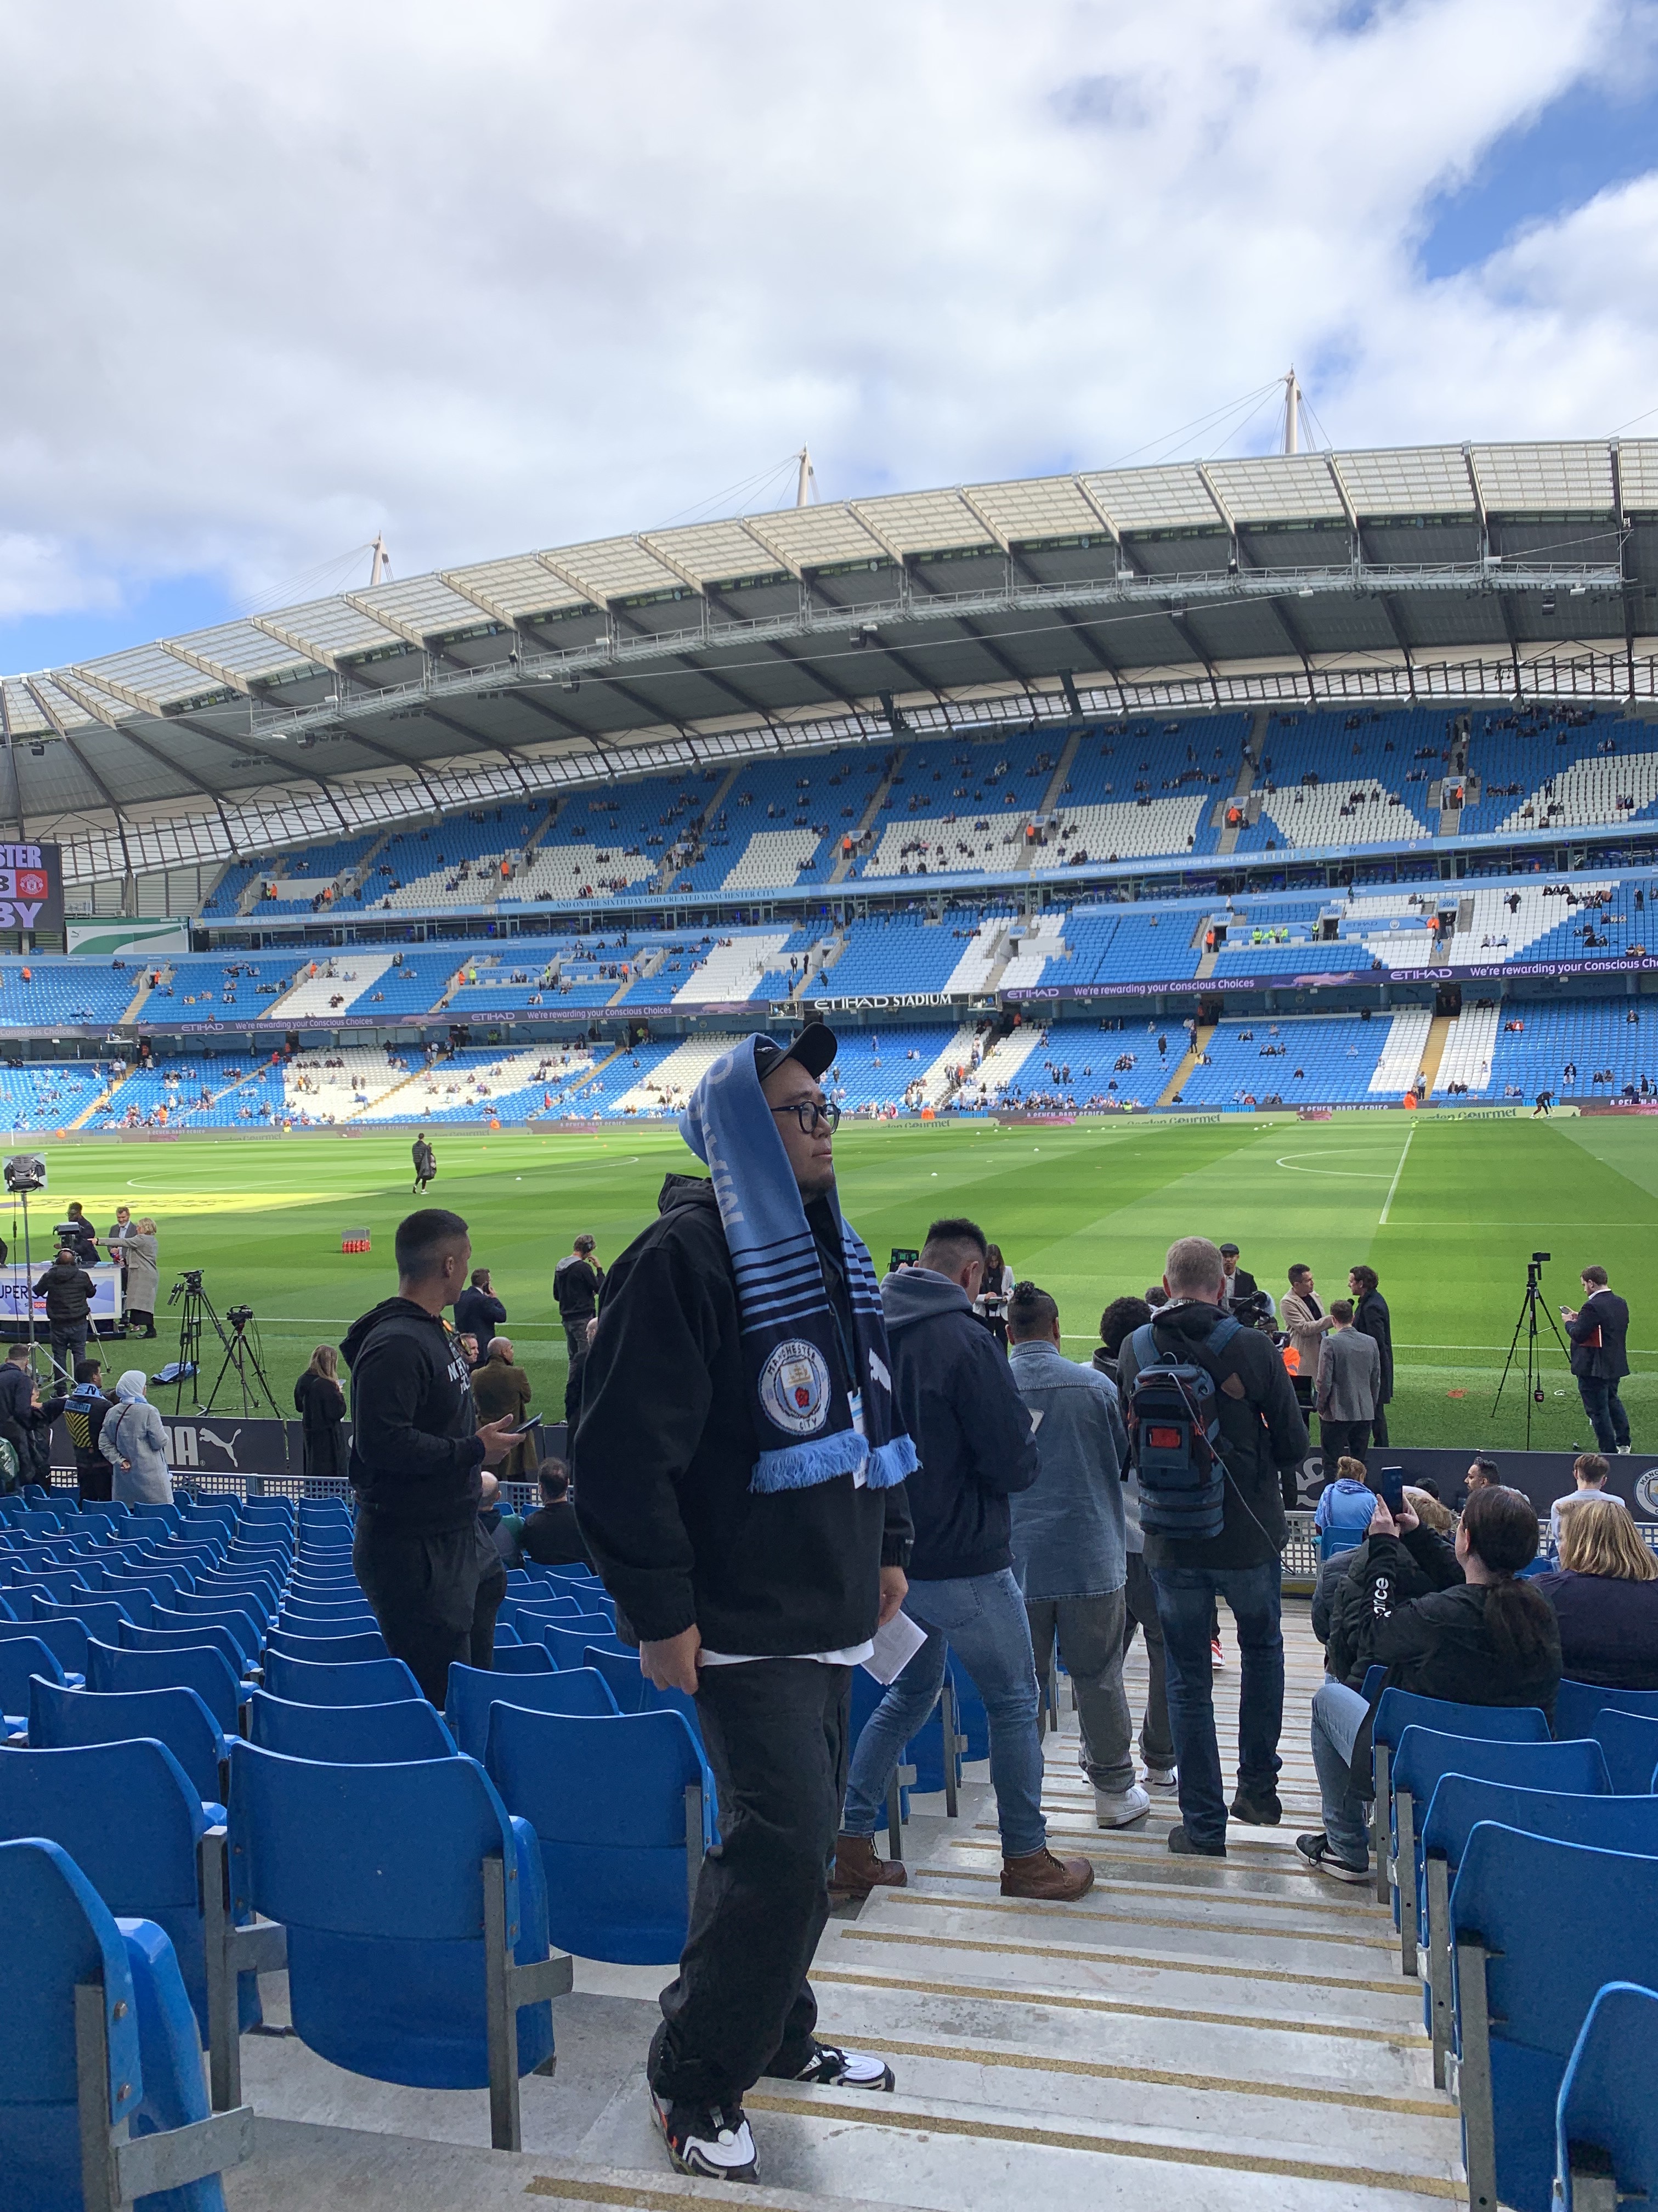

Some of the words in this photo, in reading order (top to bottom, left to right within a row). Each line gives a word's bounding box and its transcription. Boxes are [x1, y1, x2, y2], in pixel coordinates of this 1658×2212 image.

[1499, 831, 1529, 839] football
[1101, 864, 1144, 873] MANCHESTER
[664, 894, 700, 902] CREATED
[702, 891, 755, 900] MANCHESTER
[1390, 968, 1452, 980] ETIHAD
[1470, 966, 1500, 977] We're
[1502, 963, 1555, 975] rewarding
[1558, 962, 1582, 974] your
[1585, 959, 1640, 970] Conscious
[1007, 988, 1059, 998] ETIHAD
[1074, 986, 1099, 995] We're
[1101, 984, 1145, 995] rewarding
[1147, 984, 1167, 993] your
[1169, 981, 1216, 991] Conscious
[1218, 979, 1254, 989] Choices
[814, 996, 889, 1009] ETIHAD
[893, 994, 952, 1006] STADIUM
[471, 1012, 515, 1021] ETIHAD
[550, 1009, 585, 1019] rewarding
[587, 1009, 604, 1018] your
[605, 1007, 642, 1015] Conscious
[182, 1023, 224, 1031] ETIHAD
[256, 1020, 291, 1030] rewarding
[292, 1020, 308, 1029] your
[1, 1028, 42, 1036] Conscious
[44, 1027, 75, 1035] Choices
[1169, 1114, 1220, 1124] Gourmet
[1458, 1108, 1517, 1119] Gourmet
[768, 1345, 815, 1375] MANCHESTER
[799, 1418, 817, 1430] CITY
